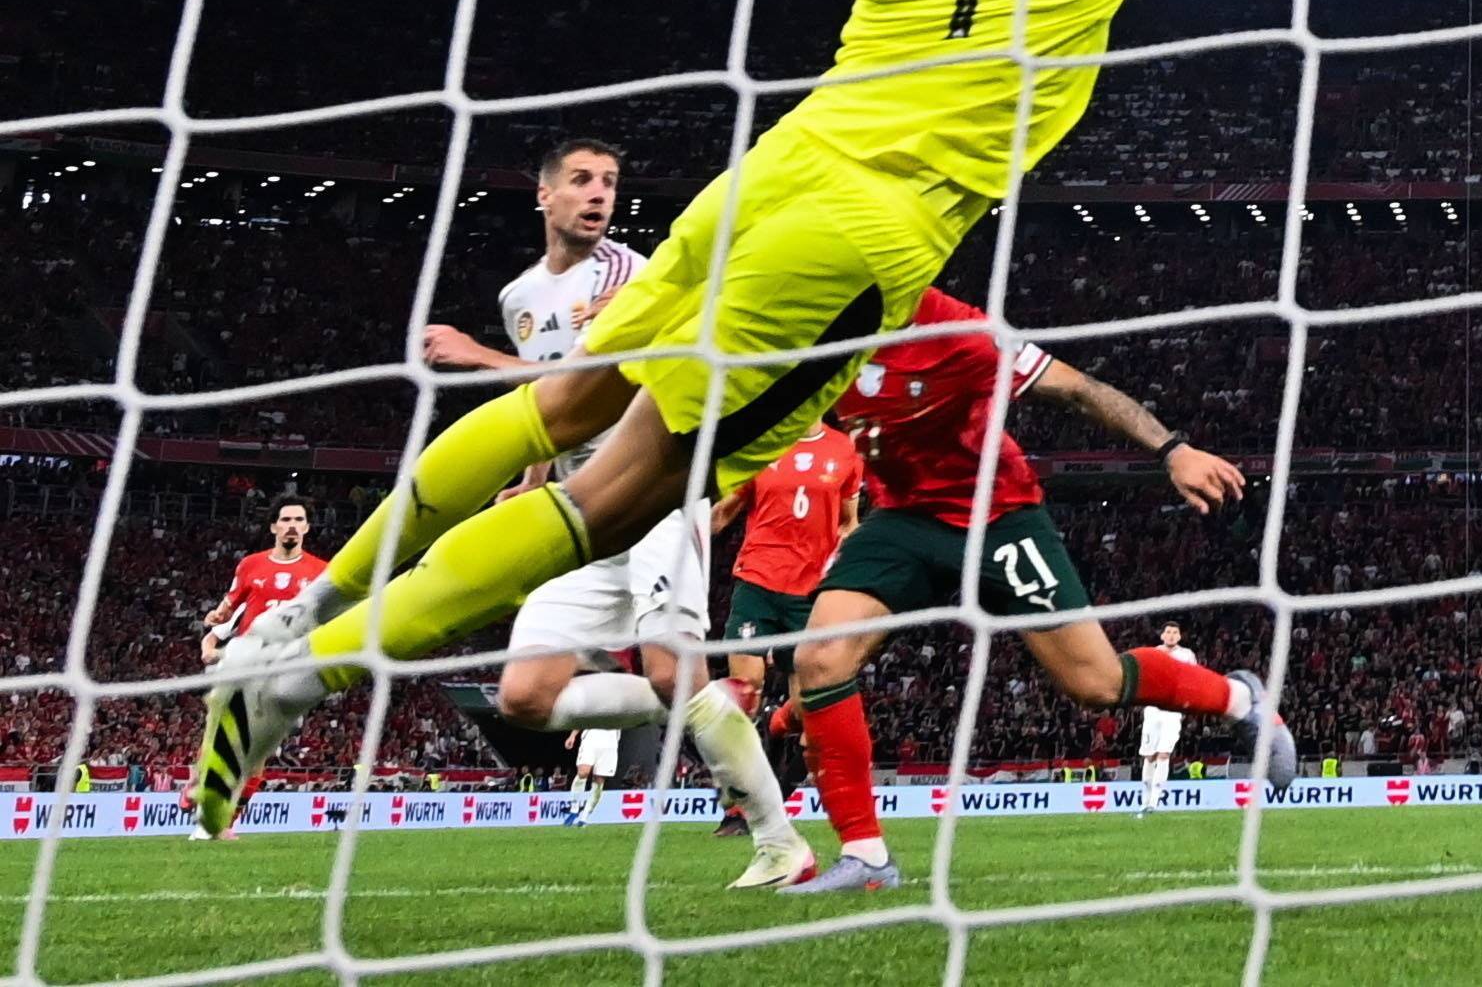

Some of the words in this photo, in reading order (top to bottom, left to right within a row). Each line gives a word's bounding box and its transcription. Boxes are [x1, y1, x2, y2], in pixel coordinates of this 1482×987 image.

[792, 486, 810, 519] 6
[993, 537, 1059, 597] 21
[962, 791, 1049, 810] WÜRTH
[35, 804, 97, 829] WRTH
